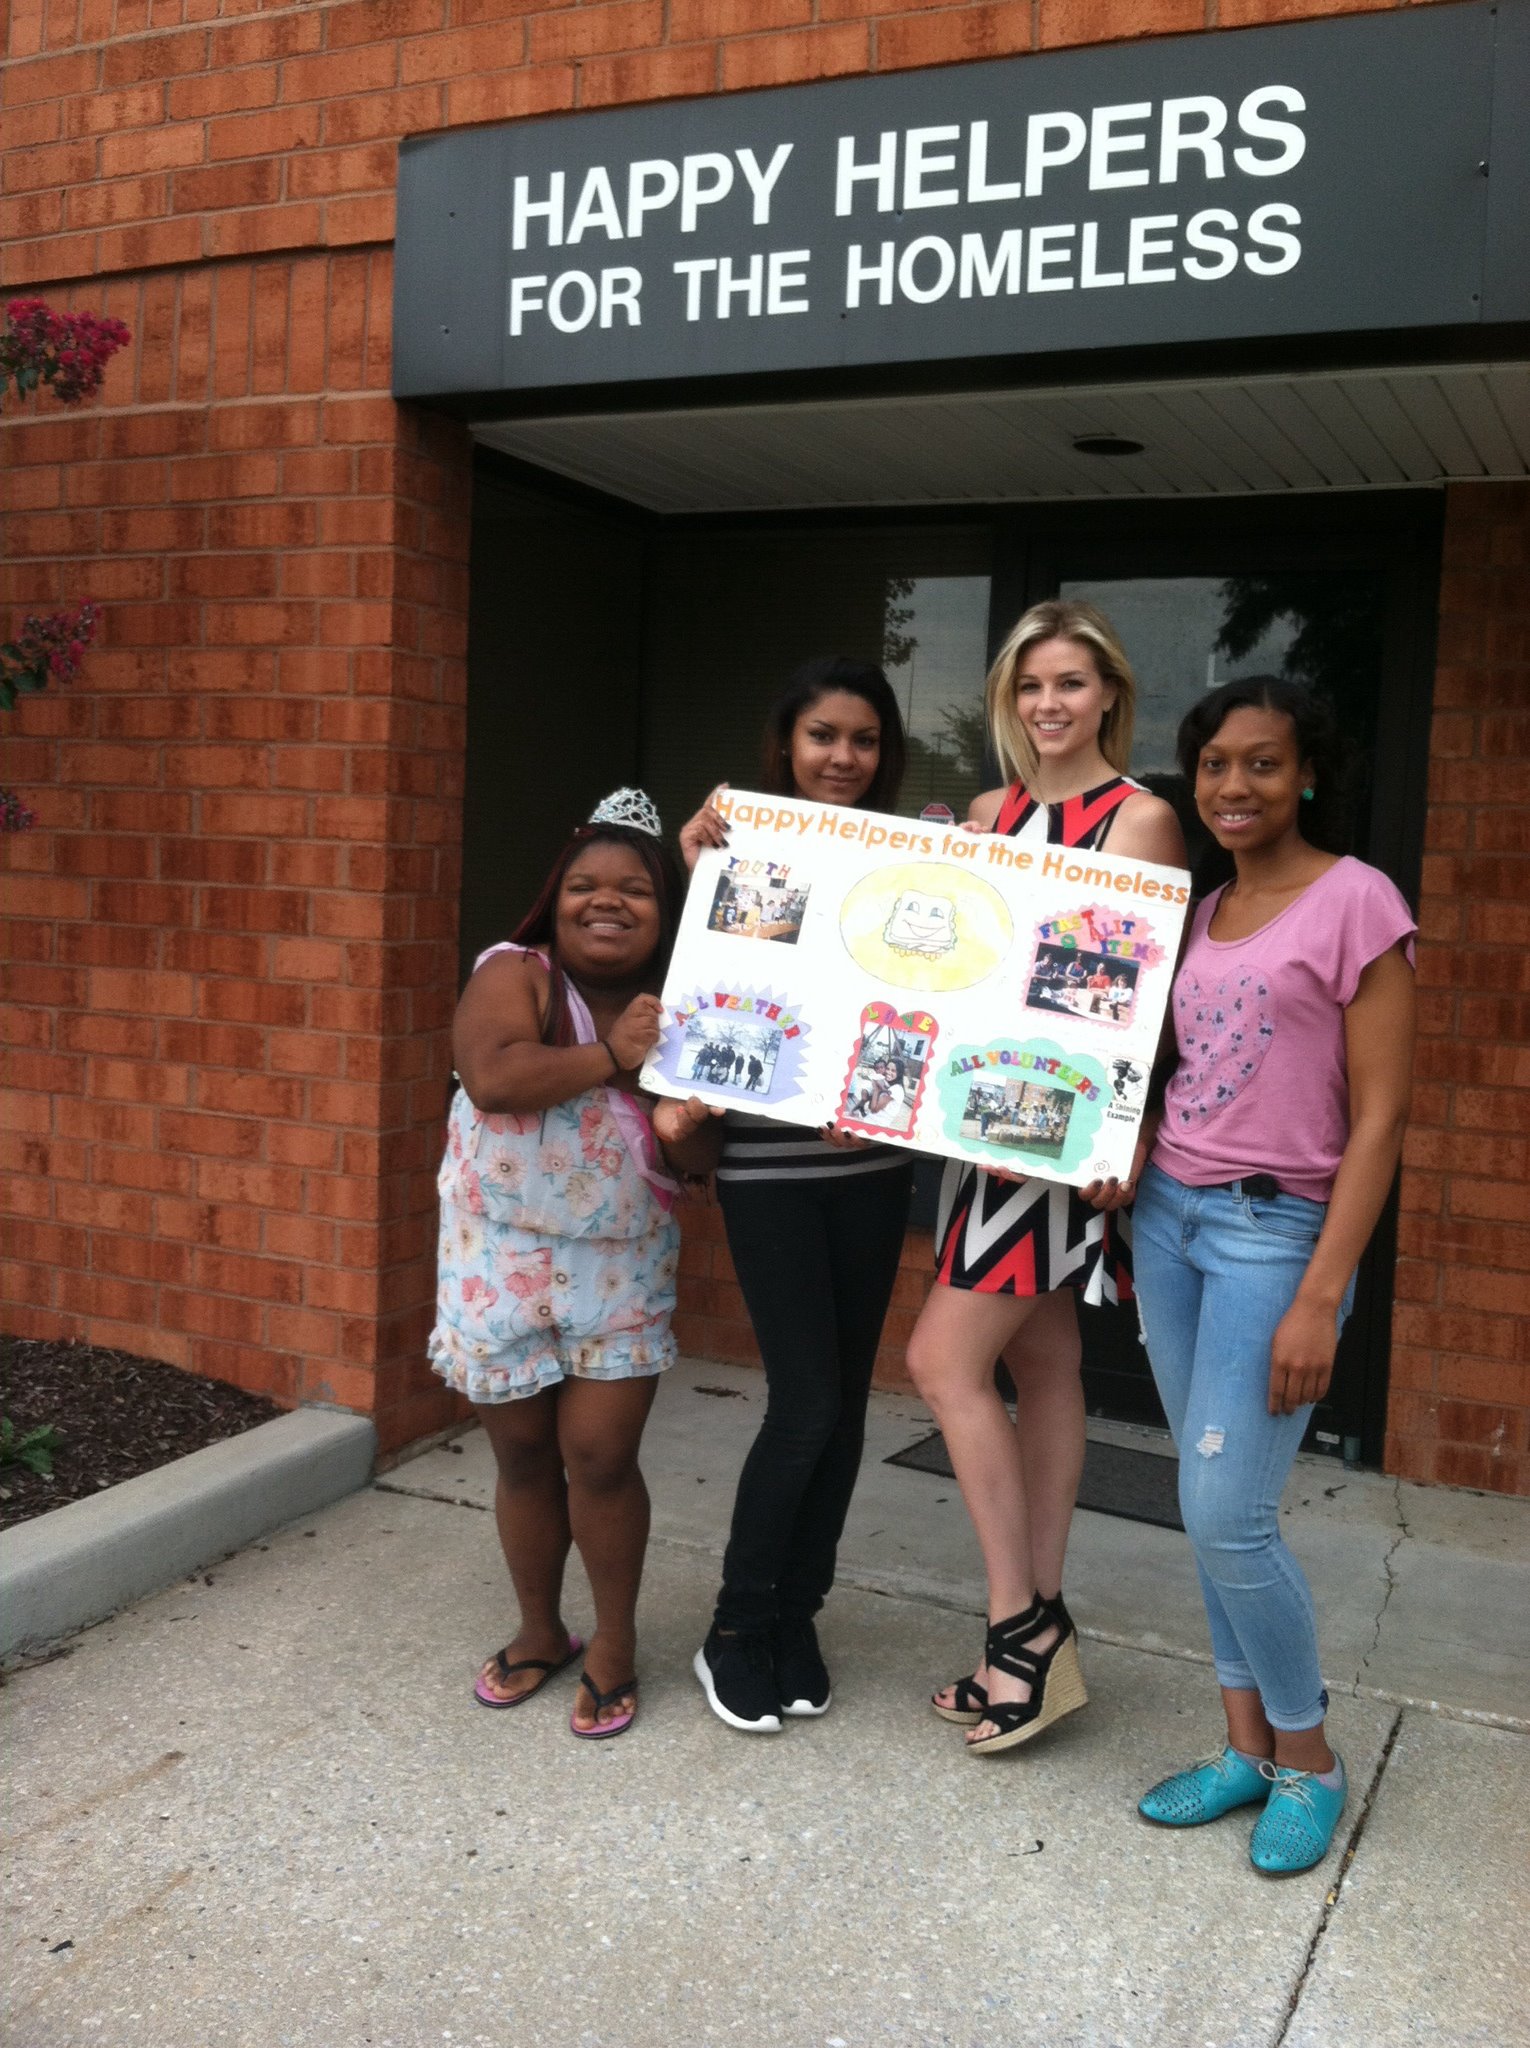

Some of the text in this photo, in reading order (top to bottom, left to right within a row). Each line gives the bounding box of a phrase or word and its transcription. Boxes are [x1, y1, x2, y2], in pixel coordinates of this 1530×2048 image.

[511, 84, 1307, 252] HAPPY HELPERS
[509, 202, 1302, 336] FOR THE HOMELESS
[715, 794, 1190, 905] Happy Helpers for the Homeless
[727, 856, 792, 878] YOUTH
[1039, 909, 1094, 939] FIRST
[675, 992, 801, 1040] ALL WEATHER
[866, 1005, 934, 1032] LOVE
[950, 1050, 1100, 1102] ALL VOLUNTEERS
[1107, 1111, 1136, 1123] Example
[1115, 1103, 1141, 1116] Shining
